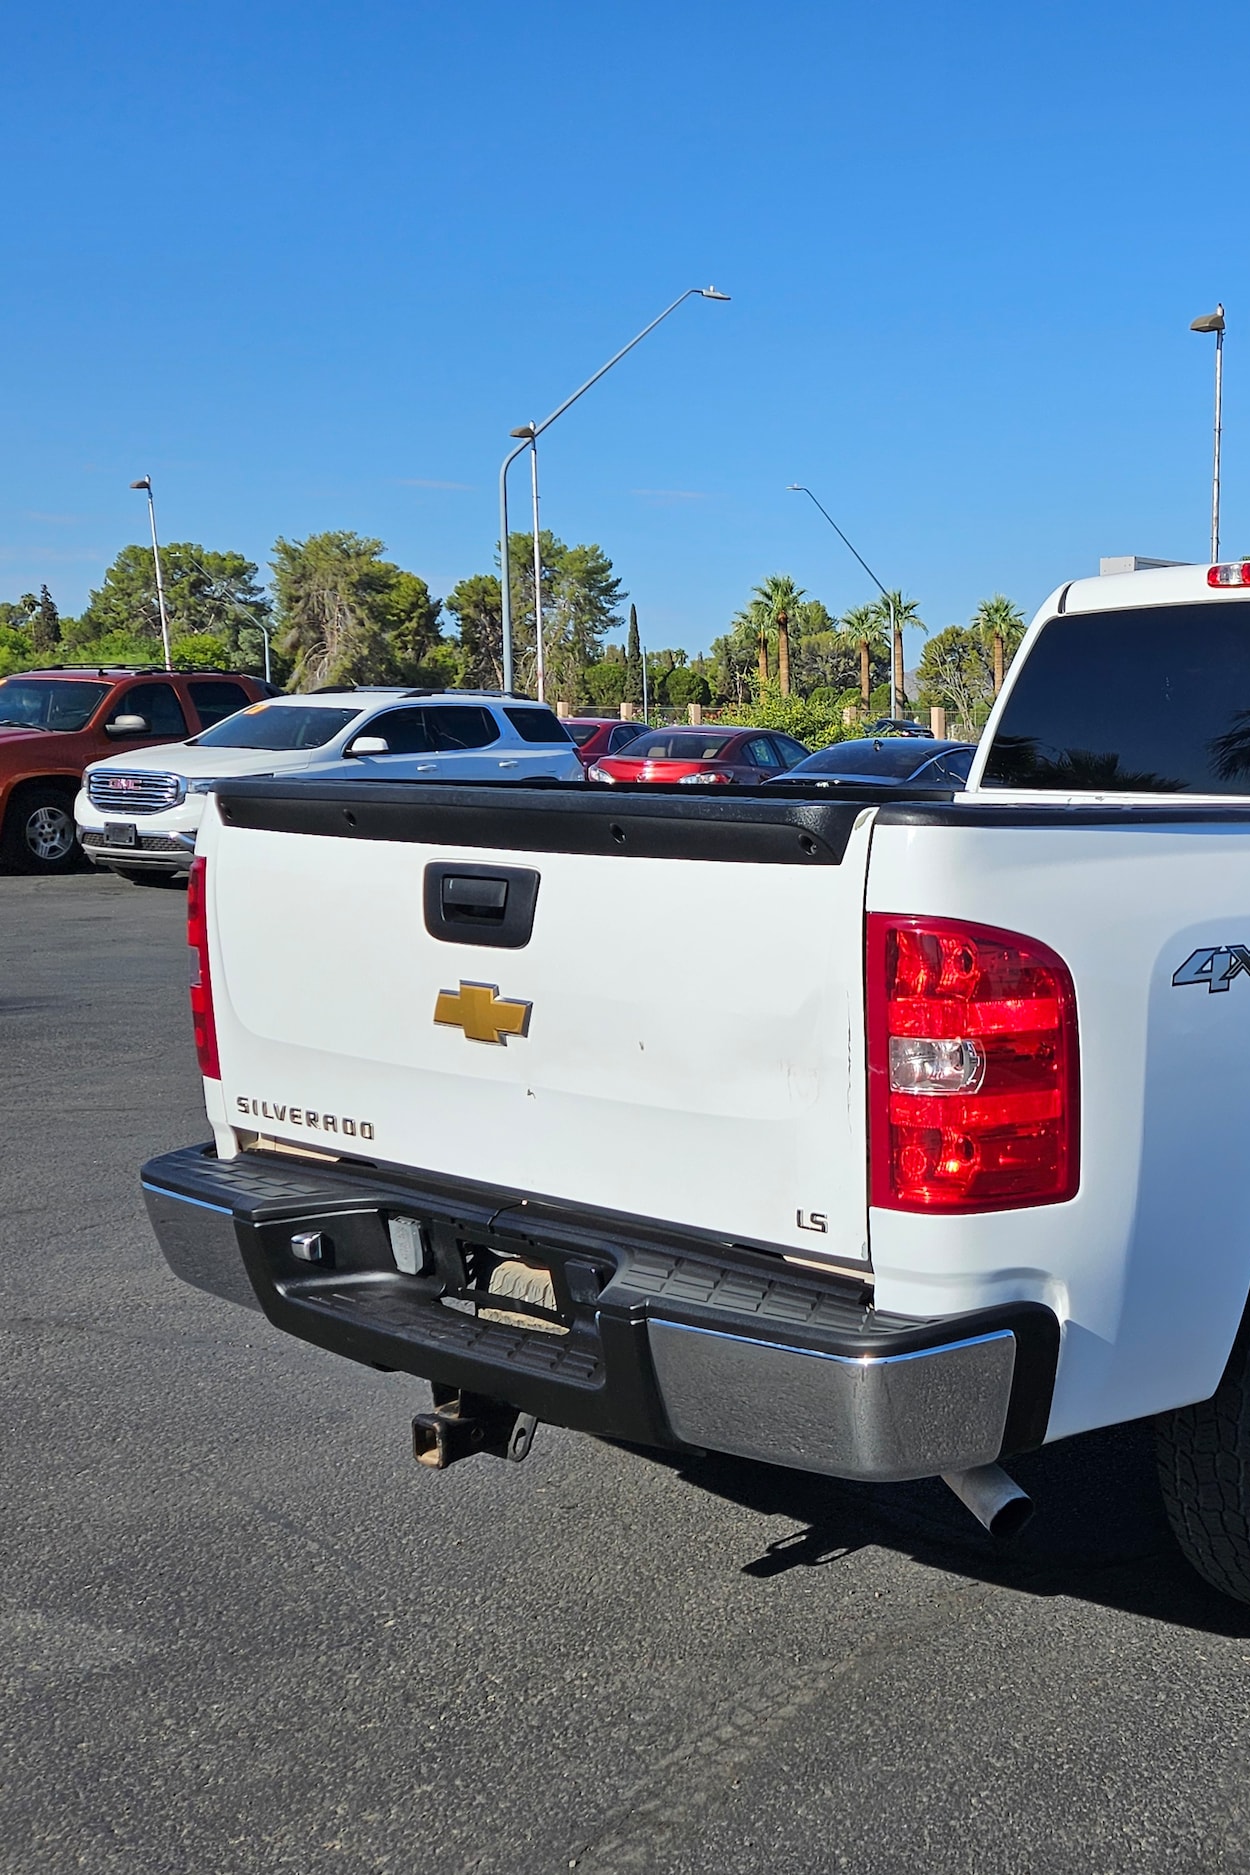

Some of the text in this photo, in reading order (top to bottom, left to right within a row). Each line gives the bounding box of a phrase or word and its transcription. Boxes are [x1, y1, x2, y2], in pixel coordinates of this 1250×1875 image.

[109, 778, 142, 790] GMC
[236, 1096, 375, 1140] SILVERADO
[797, 1209, 829, 1234] LS
